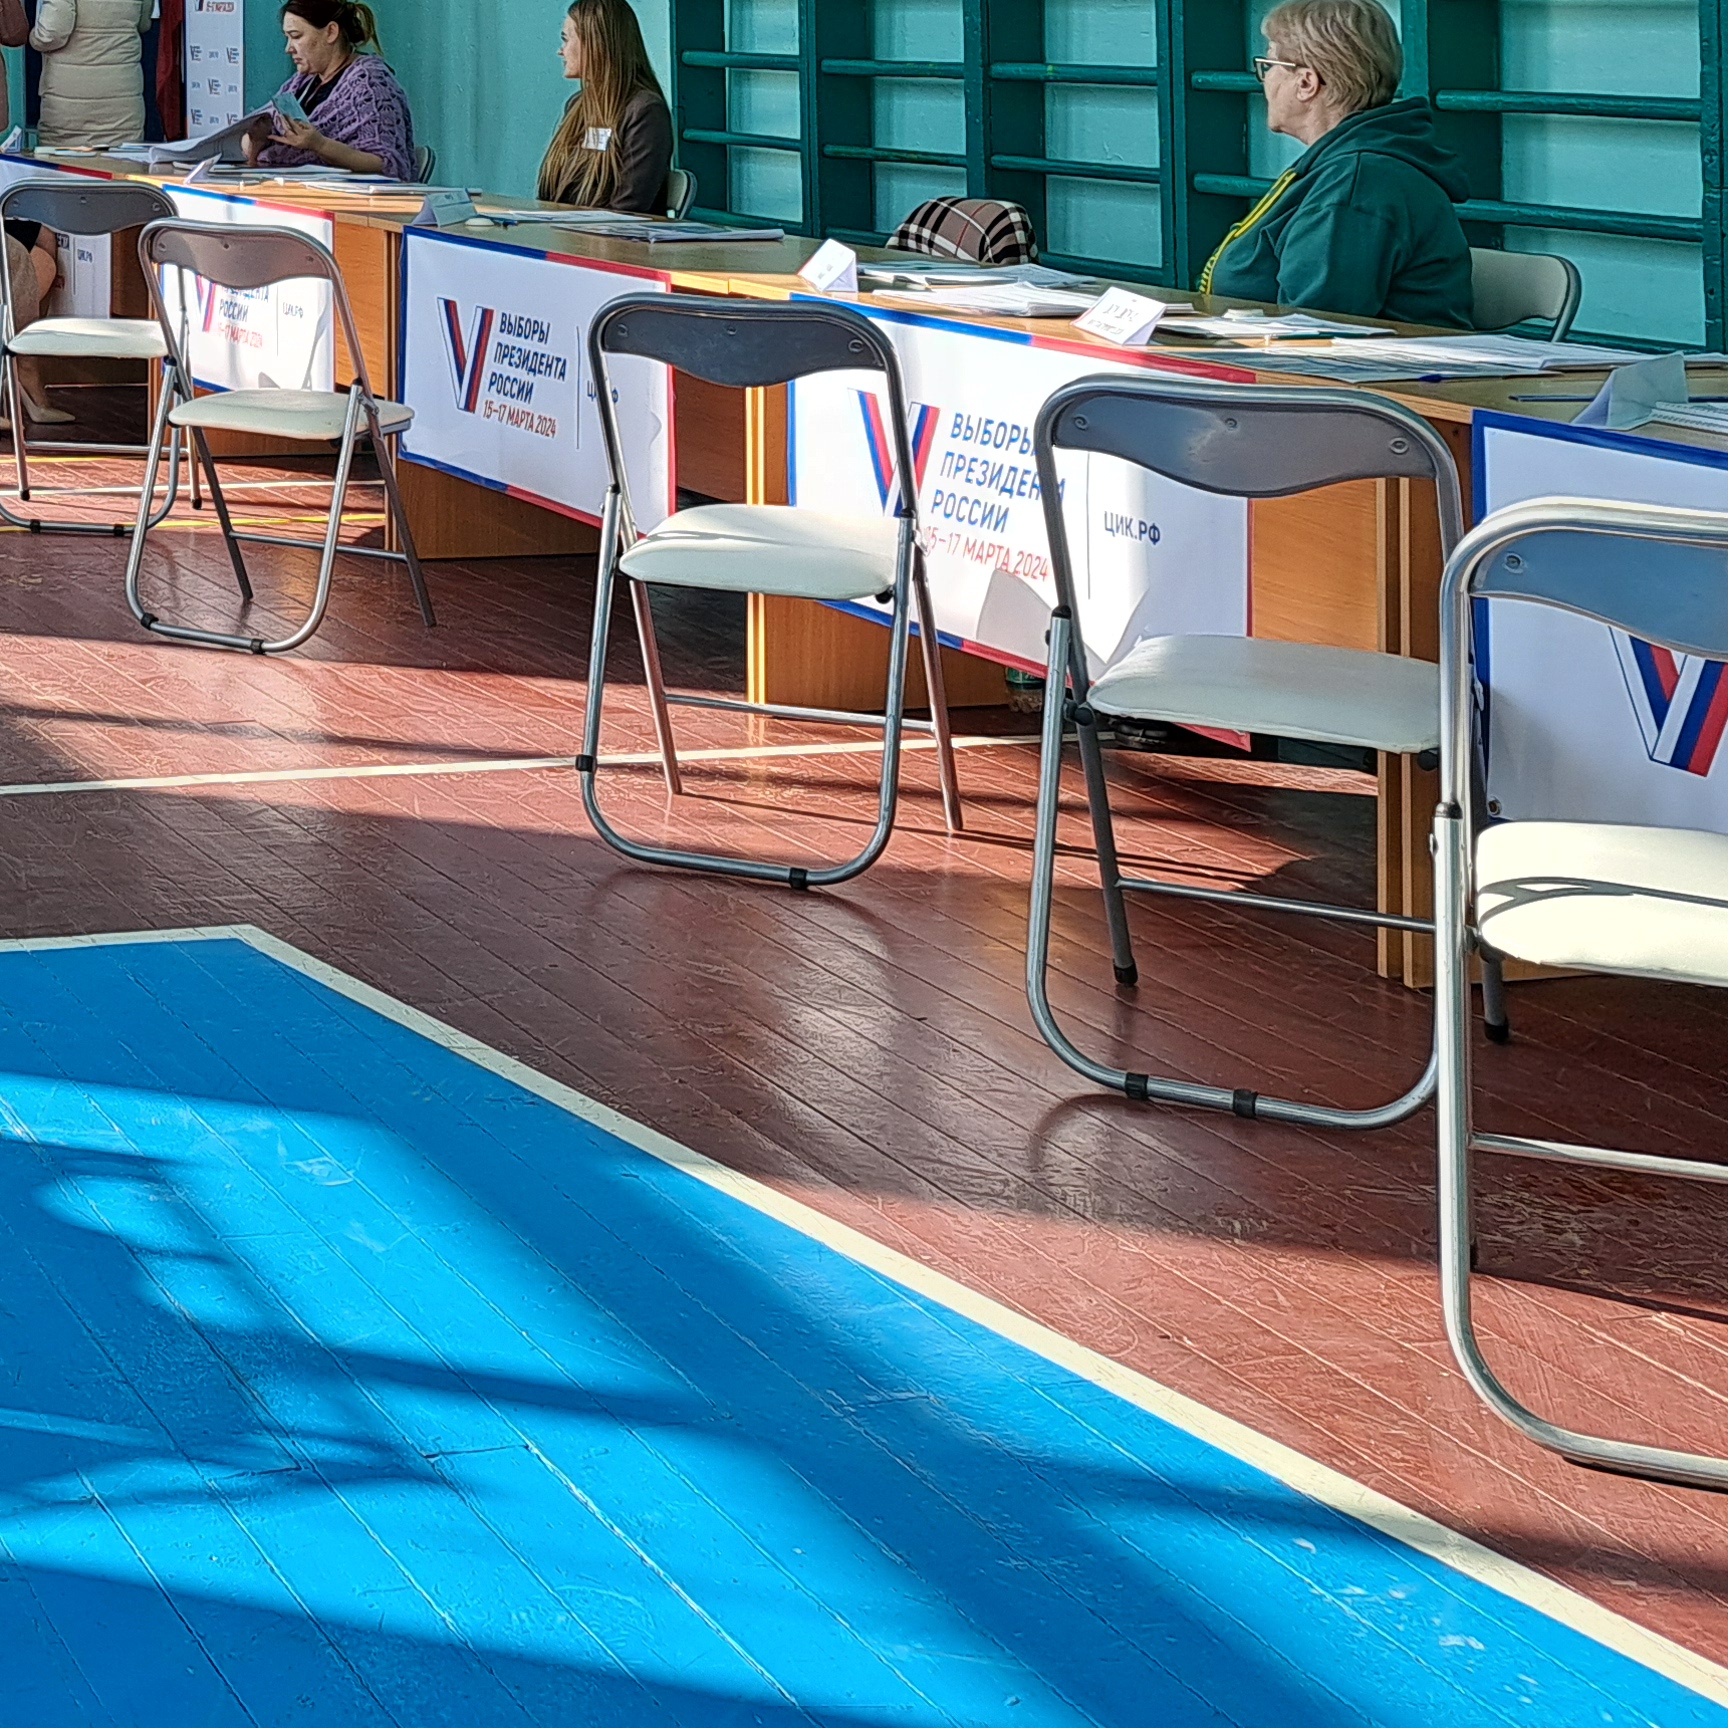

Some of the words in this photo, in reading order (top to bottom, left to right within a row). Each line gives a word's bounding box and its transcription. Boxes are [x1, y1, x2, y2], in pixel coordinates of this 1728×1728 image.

[218, 298, 250, 323] РОССИИ
[498, 312, 551, 345] ВЫБОРЫ
[493, 341, 567, 382] ПРЕЗИДЕНТА
[487, 371, 534, 405] РОССИИ
[506, 404, 535, 432] МАРТА
[534, 414, 557, 439] 2024
[930, 488, 1010, 534] РОССИИ
[1104, 510, 1161, 546] ЦИК.РФ
[962, 536, 1012, 574] МАРТА
[1013, 551, 1049, 583] 2024
